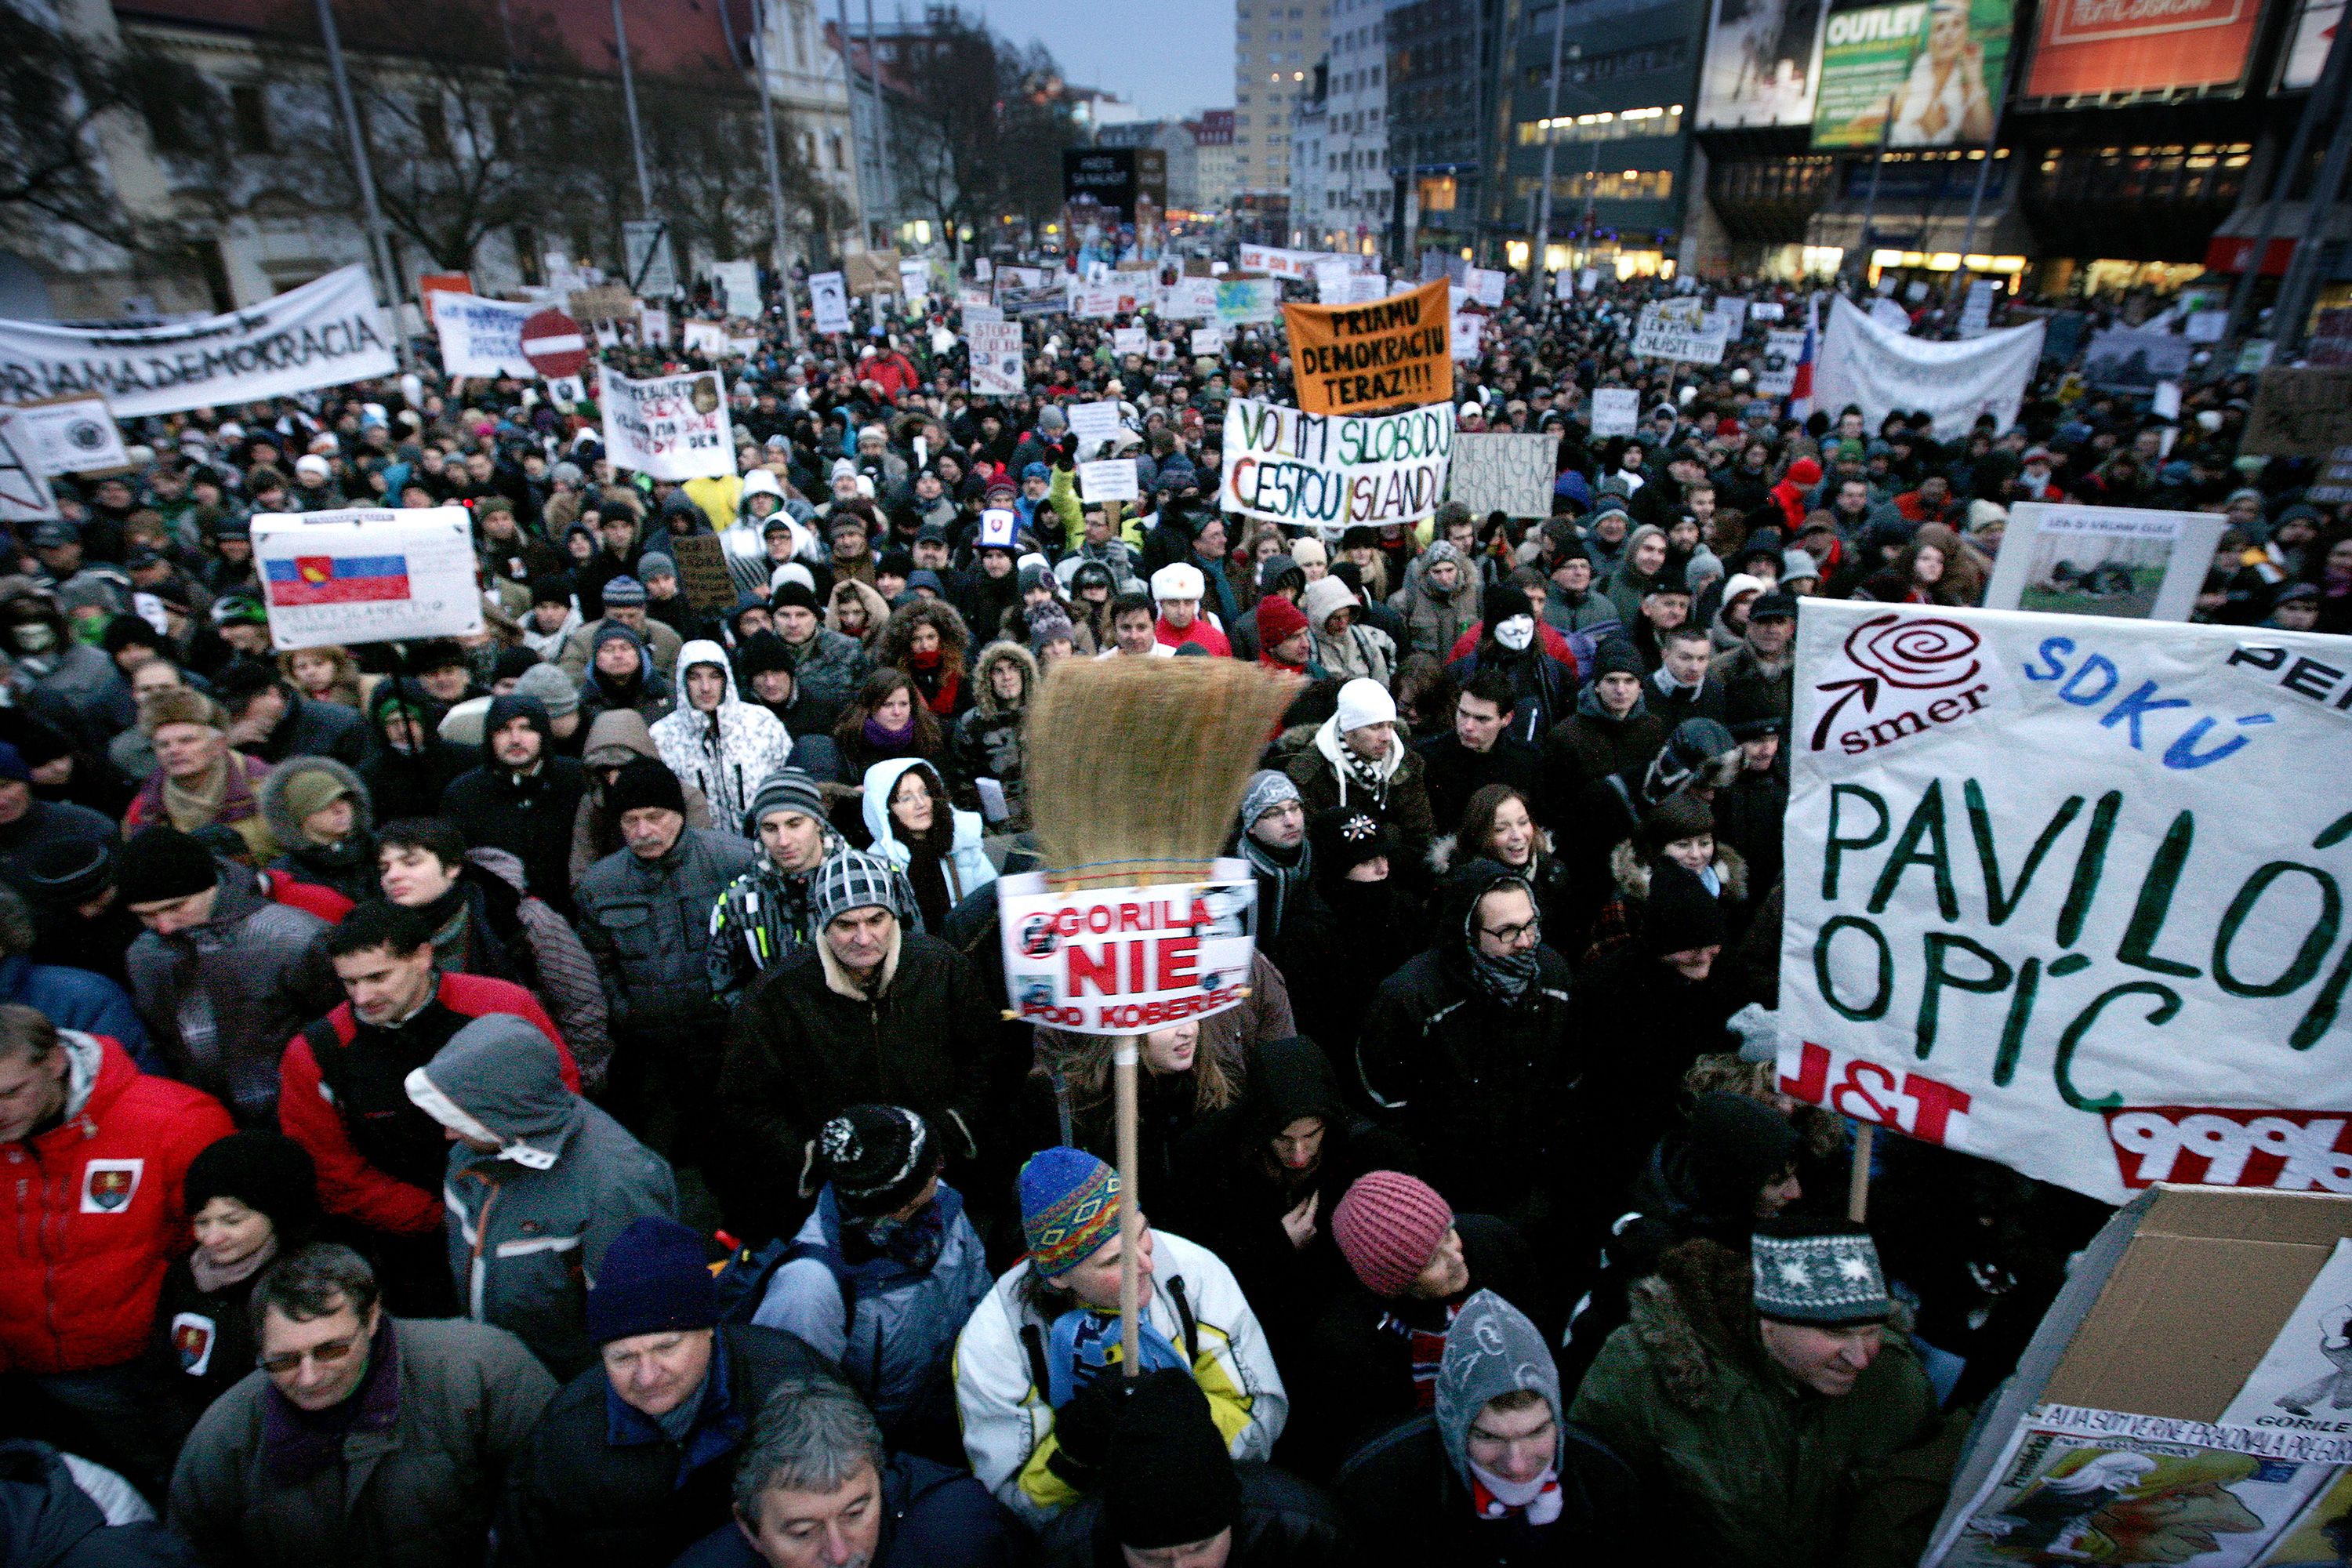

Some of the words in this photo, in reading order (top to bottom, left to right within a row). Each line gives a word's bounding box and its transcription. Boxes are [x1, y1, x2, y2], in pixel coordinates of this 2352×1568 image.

[1827, 3, 1928, 46] OUTLET
[1333, 296, 1420, 337] PRIAMU
[149, 314, 383, 387] DEMOKRACIA
[1301, 325, 1446, 375] DEMOKRACIU
[1323, 363, 1432, 406] TERAZ!!!
[1338, 407, 1451, 466] SLOBODU
[1231, 457, 1342, 521] CESTOU
[2024, 637, 2276, 770] SDKÚ
[2227, 648, 2352, 710] PE
[1840, 681, 1989, 756] smer
[1056, 898, 1212, 937] GORILA
[1066, 936, 1201, 997] NIE
[1098, 983, 1245, 1029] KOBEREC
[1813, 914, 2183, 1113] OPÍC
[1779, 1040, 1975, 1146] J&T
